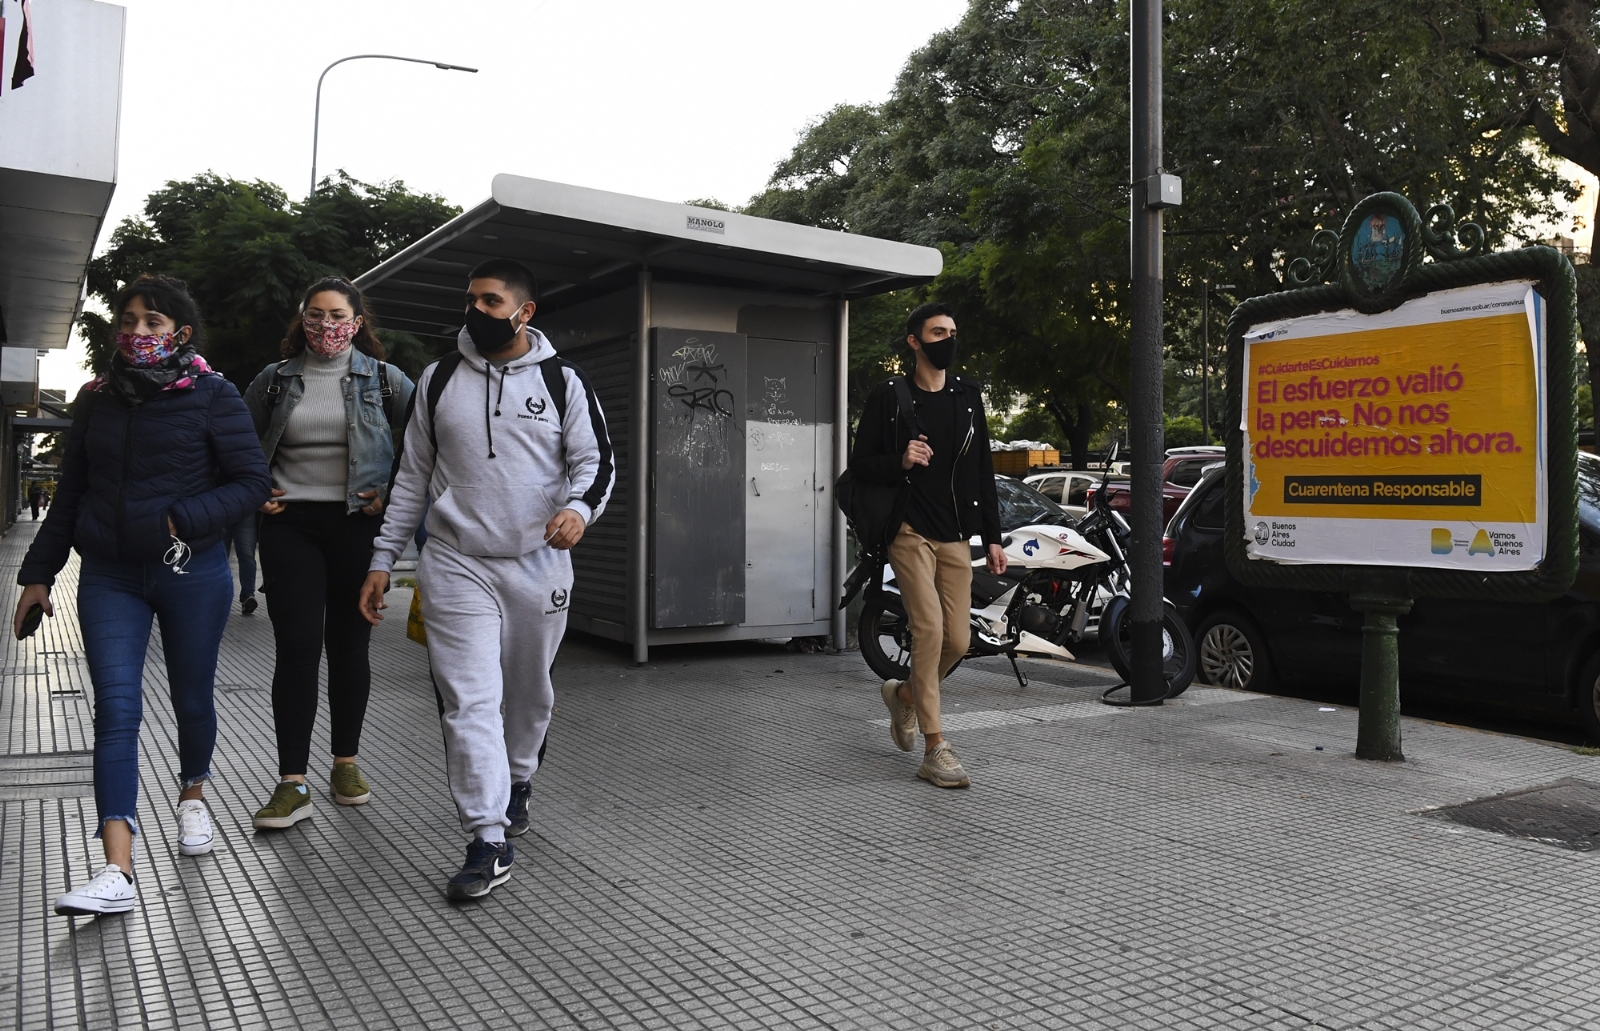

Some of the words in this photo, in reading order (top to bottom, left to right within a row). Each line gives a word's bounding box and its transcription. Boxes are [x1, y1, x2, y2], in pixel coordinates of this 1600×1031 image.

[688, 217, 724, 229] MANOLO
[1440, 299, 1525, 315] buenosaires.gob.ar/coronavirus
[1258, 355, 1380, 376] #CuidarteEsCuidamos
[1257, 379, 1278, 405] El
[1282, 375, 1391, 402] esfuerzo
[1395, 362, 1464, 396] valió
[1256, 407, 1275, 432] la
[1353, 401, 1393, 427] No
[1398, 402, 1450, 425] nos
[1254, 431, 1423, 459] descuidemos
[1427, 427, 1523, 456] ahora.
[1288, 482, 1370, 497] Cuarentena
[1372, 480, 1476, 499] Responsable
[1271, 521, 1297, 531] Buenos
[1271, 530, 1290, 539] Aires
[1488, 531, 1516, 540] Vamos
[1271, 538, 1296, 547] Ciudad
[1493, 539, 1524, 548] Buenos
[1498, 547, 1521, 556] Aires
